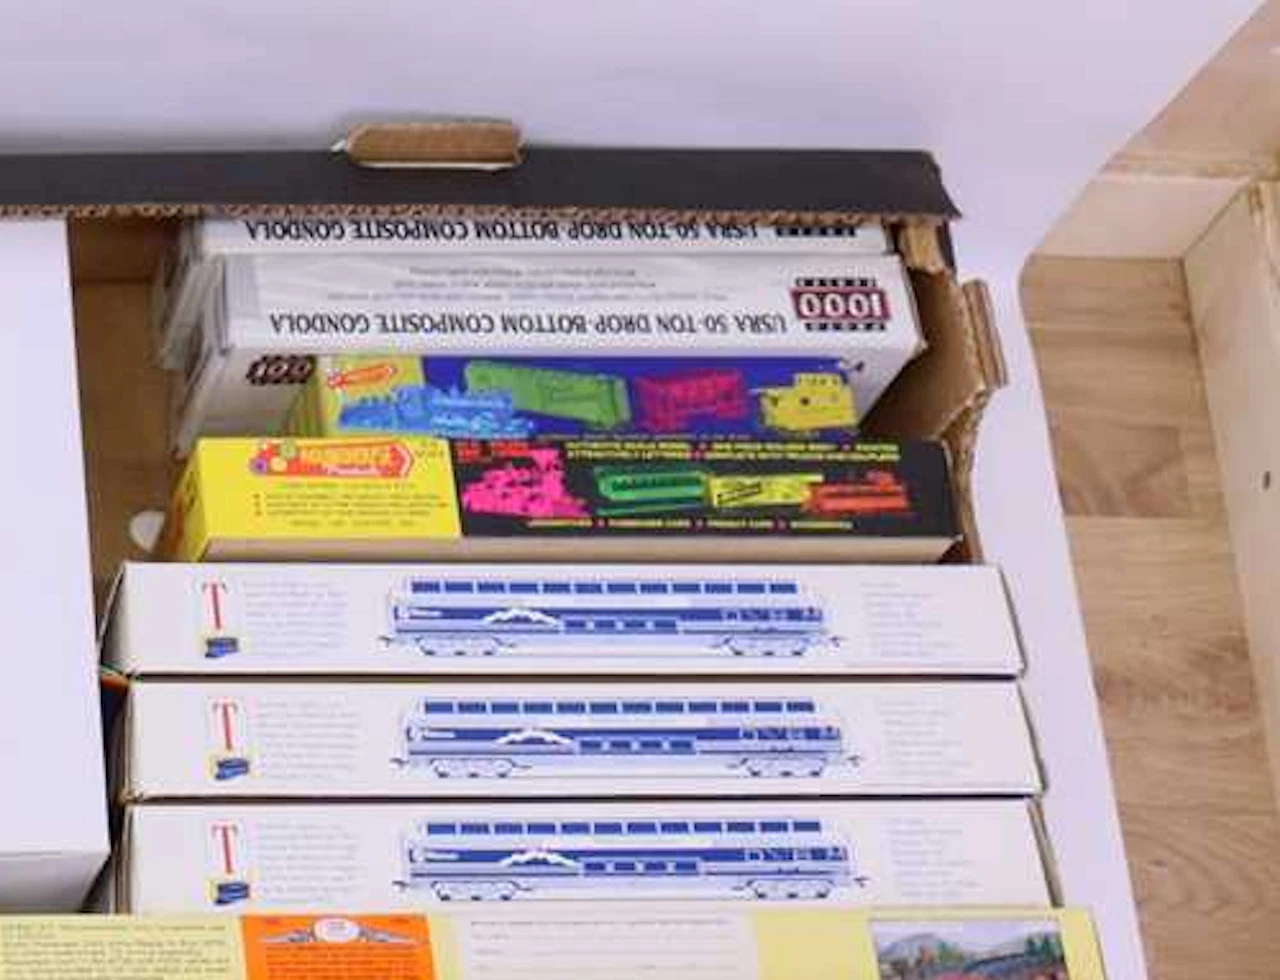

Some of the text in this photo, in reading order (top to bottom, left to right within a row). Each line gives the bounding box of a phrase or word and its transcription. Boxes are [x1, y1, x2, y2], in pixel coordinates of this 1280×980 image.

[244, 219, 344, 241] GONDOLA
[348, 219, 467, 241] COMPOSITE
[473, 219, 621, 241] DROP-BOTTOM
[625, 219, 700, 241] 50-TON
[798, 293, 883, 317] 1000
[268, 310, 370, 334] GONDOLA
[375, 310, 494, 334] COMPOSITE
[500, 310, 650, 334] DROP-BOTTOM
[653, 312, 729, 334] 50-TON
[734, 312, 788, 334] USRA
